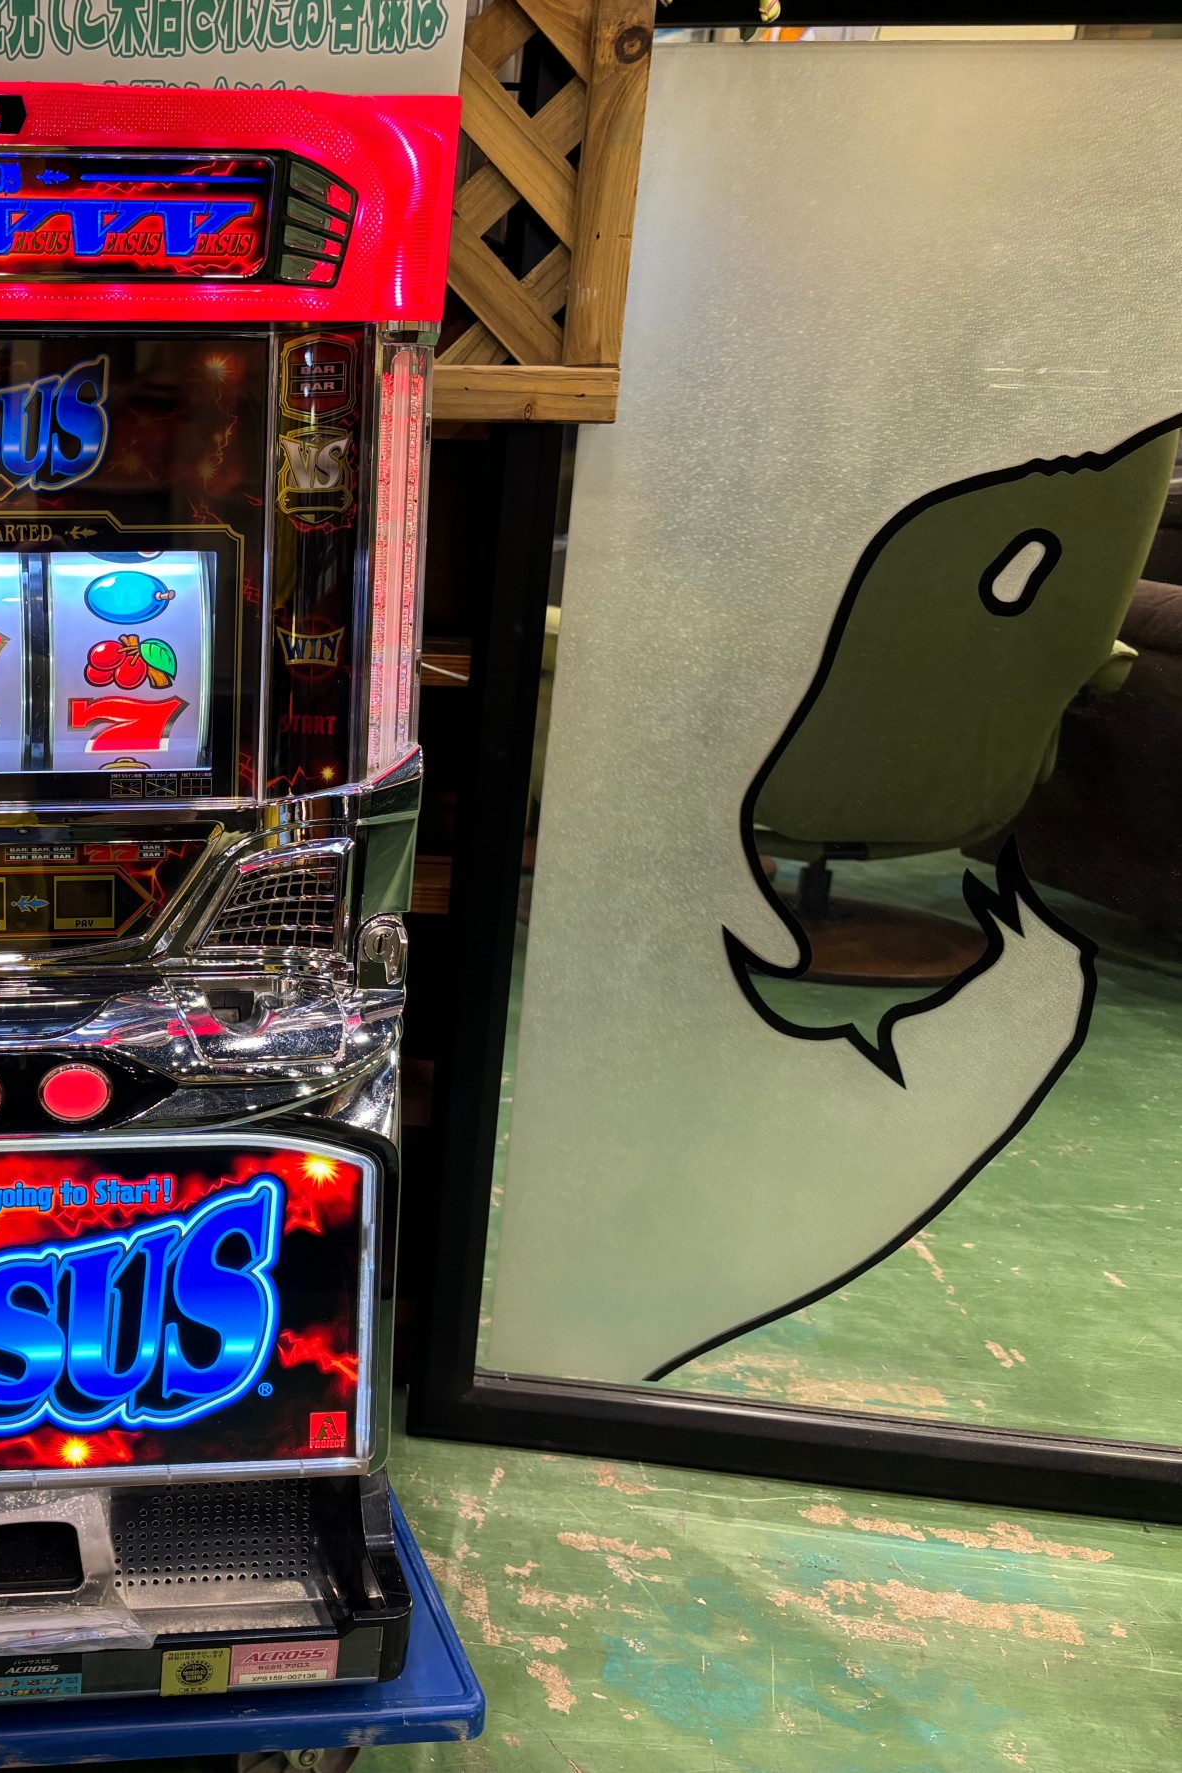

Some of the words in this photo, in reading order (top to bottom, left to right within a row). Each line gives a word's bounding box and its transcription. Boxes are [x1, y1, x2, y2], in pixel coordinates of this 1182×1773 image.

[300, 365, 336, 375] BAR
[279, 432, 353, 490] VS
[279, 629, 343, 664] WIN
[67, 695, 189, 754] 7
[279, 714, 336, 736] START
[75, 919, 94, 928] PAY
[59, 1179, 84, 1207] to
[93, 1176, 172, 1206] Start!
[309, 1439, 346, 1449] PROJECT
[242, 1648, 328, 1664] ACROSS
[4, 1664, 60, 1675] ACROSS
